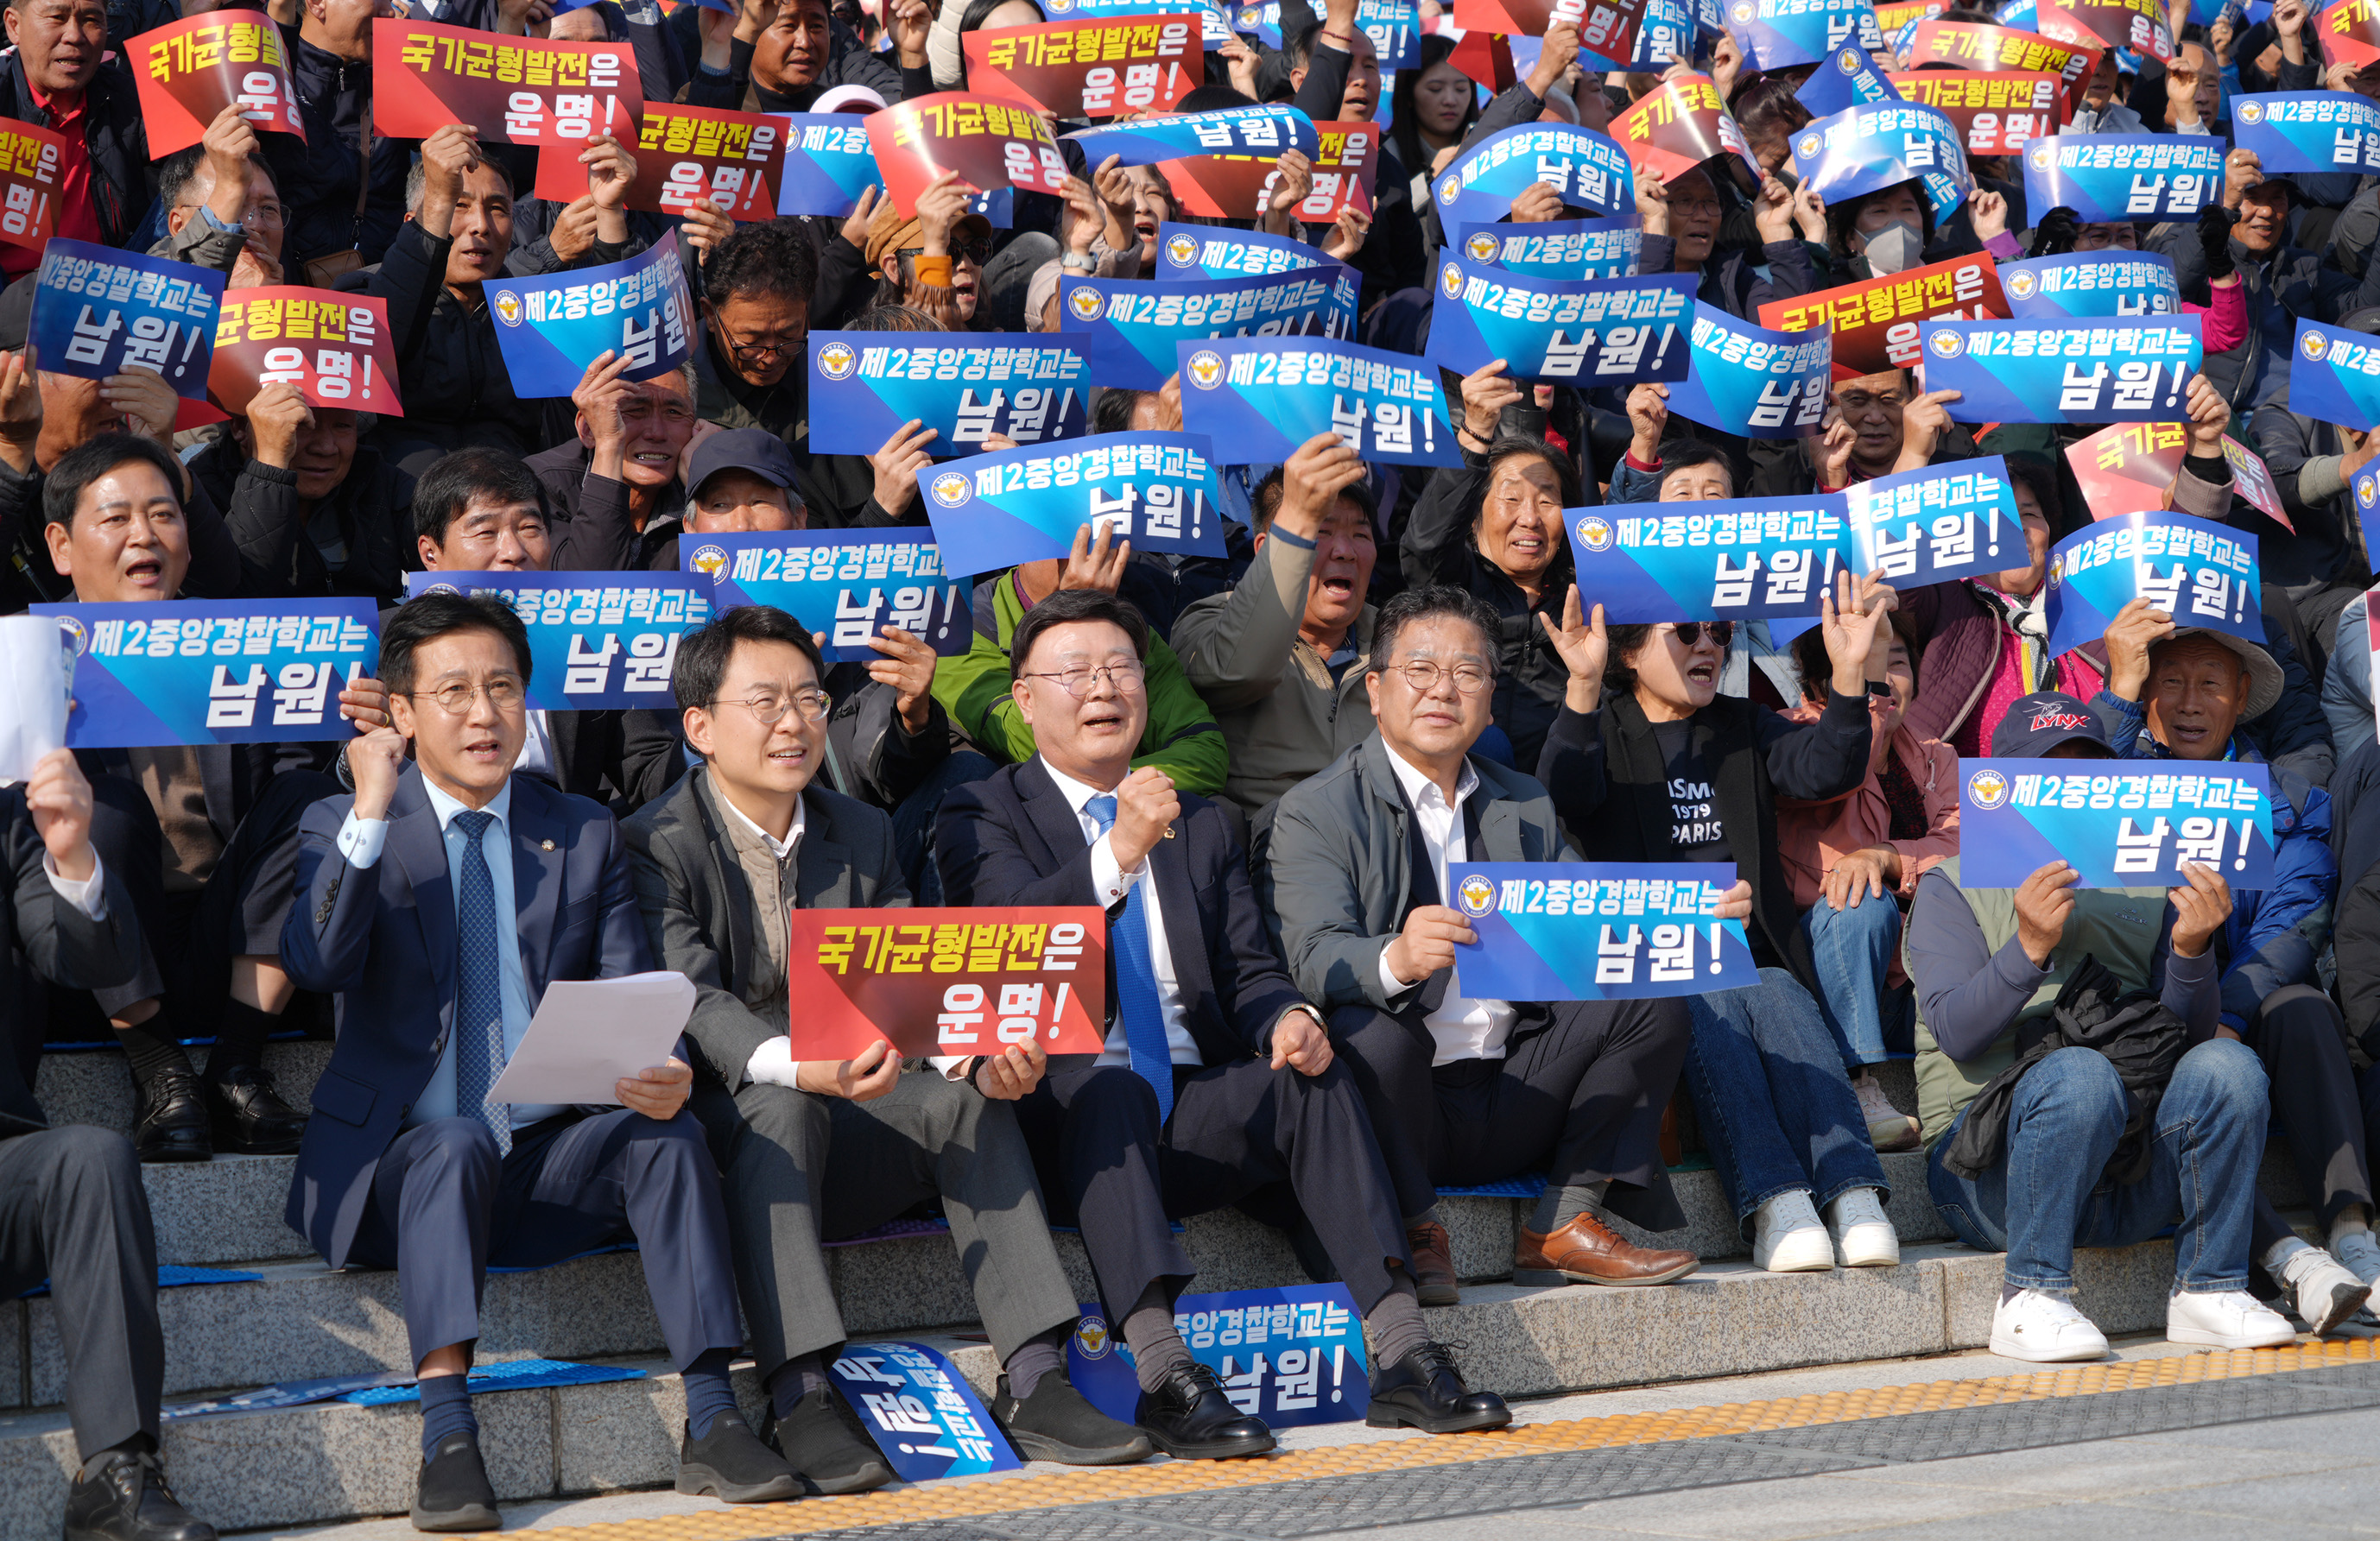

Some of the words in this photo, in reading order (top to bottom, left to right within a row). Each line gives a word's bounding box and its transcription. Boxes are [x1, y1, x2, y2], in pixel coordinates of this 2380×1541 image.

[401, 33, 621, 87] 국가균형발전은
[988, 22, 1189, 71] 국가균형발전은
[1931, 29, 2089, 82] 국가균형발전은
[1081, 61, 1180, 110] 운명!
[1895, 79, 2054, 110] 국가균형발전은
[504, 91, 616, 138] 운명!
[1192, 115, 1299, 148] 남원!
[1461, 129, 1627, 189] 제2중앙경찰학교는
[1536, 155, 1624, 211] 남원!
[2058, 144, 2222, 172] 제2중앙경찰학교는
[659, 161, 763, 212] 운명!
[2126, 174, 2219, 215] 남원!
[523, 247, 680, 323] 제2중앙경찰학교는
[1105, 278, 1327, 325] 제2중앙경찰학교는
[1463, 275, 1687, 325] 제2중앙경찰학교는
[1781, 265, 1984, 332] 국가균형발전은
[2039, 261, 2176, 293] 제2중앙경찰학교는
[64, 304, 202, 378] 남원!
[213, 298, 376, 348] 균형발전은
[622, 281, 692, 372] 남원!
[1691, 316, 1832, 376] 제2중앙경찰학교
[1966, 326, 2193, 357] 제2중앙경찰학교는
[260, 347, 372, 400] 운명!
[857, 347, 1084, 381] 제2중앙경찰학교는
[1538, 323, 1676, 377] 남원!
[1226, 351, 1435, 403] 제2중앙경찰학교는
[2058, 361, 2187, 410] 남원!
[951, 387, 1075, 442] 남원!
[1331, 394, 1435, 454] 남원!
[975, 444, 1207, 497] 제2중앙경찰학교는
[1089, 484, 1204, 540] 남원!
[1616, 509, 1842, 547] 제2중앙경찰학교는
[731, 543, 948, 583] 제2중앙경찰학교
[1875, 507, 1999, 580] 남원!
[2064, 525, 2252, 578] 제2중앙경찰학교는
[1711, 546, 1838, 608] 남원!
[2140, 561, 2247, 624] 남원!
[88, 616, 369, 658] 제2중앙경찰학교는
[832, 584, 959, 647] 남원!
[206, 660, 363, 729] 남원!
[2030, 714, 2091, 732] LYNX
[1672, 803, 1711, 819] 1979
[2009, 774, 2260, 812] 제2중앙경찰학교는
[1671, 821, 1722, 844] PARIS
[2113, 815, 2254, 874] 남원!
[1497, 879, 1725, 916] 제2중앙경찰학교는
[818, 923, 1086, 976] 국가균형발전은
[1594, 923, 1723, 984] 남원!
[936, 982, 1072, 1045] 운명!
[1219, 1343, 1345, 1415] 남원!
